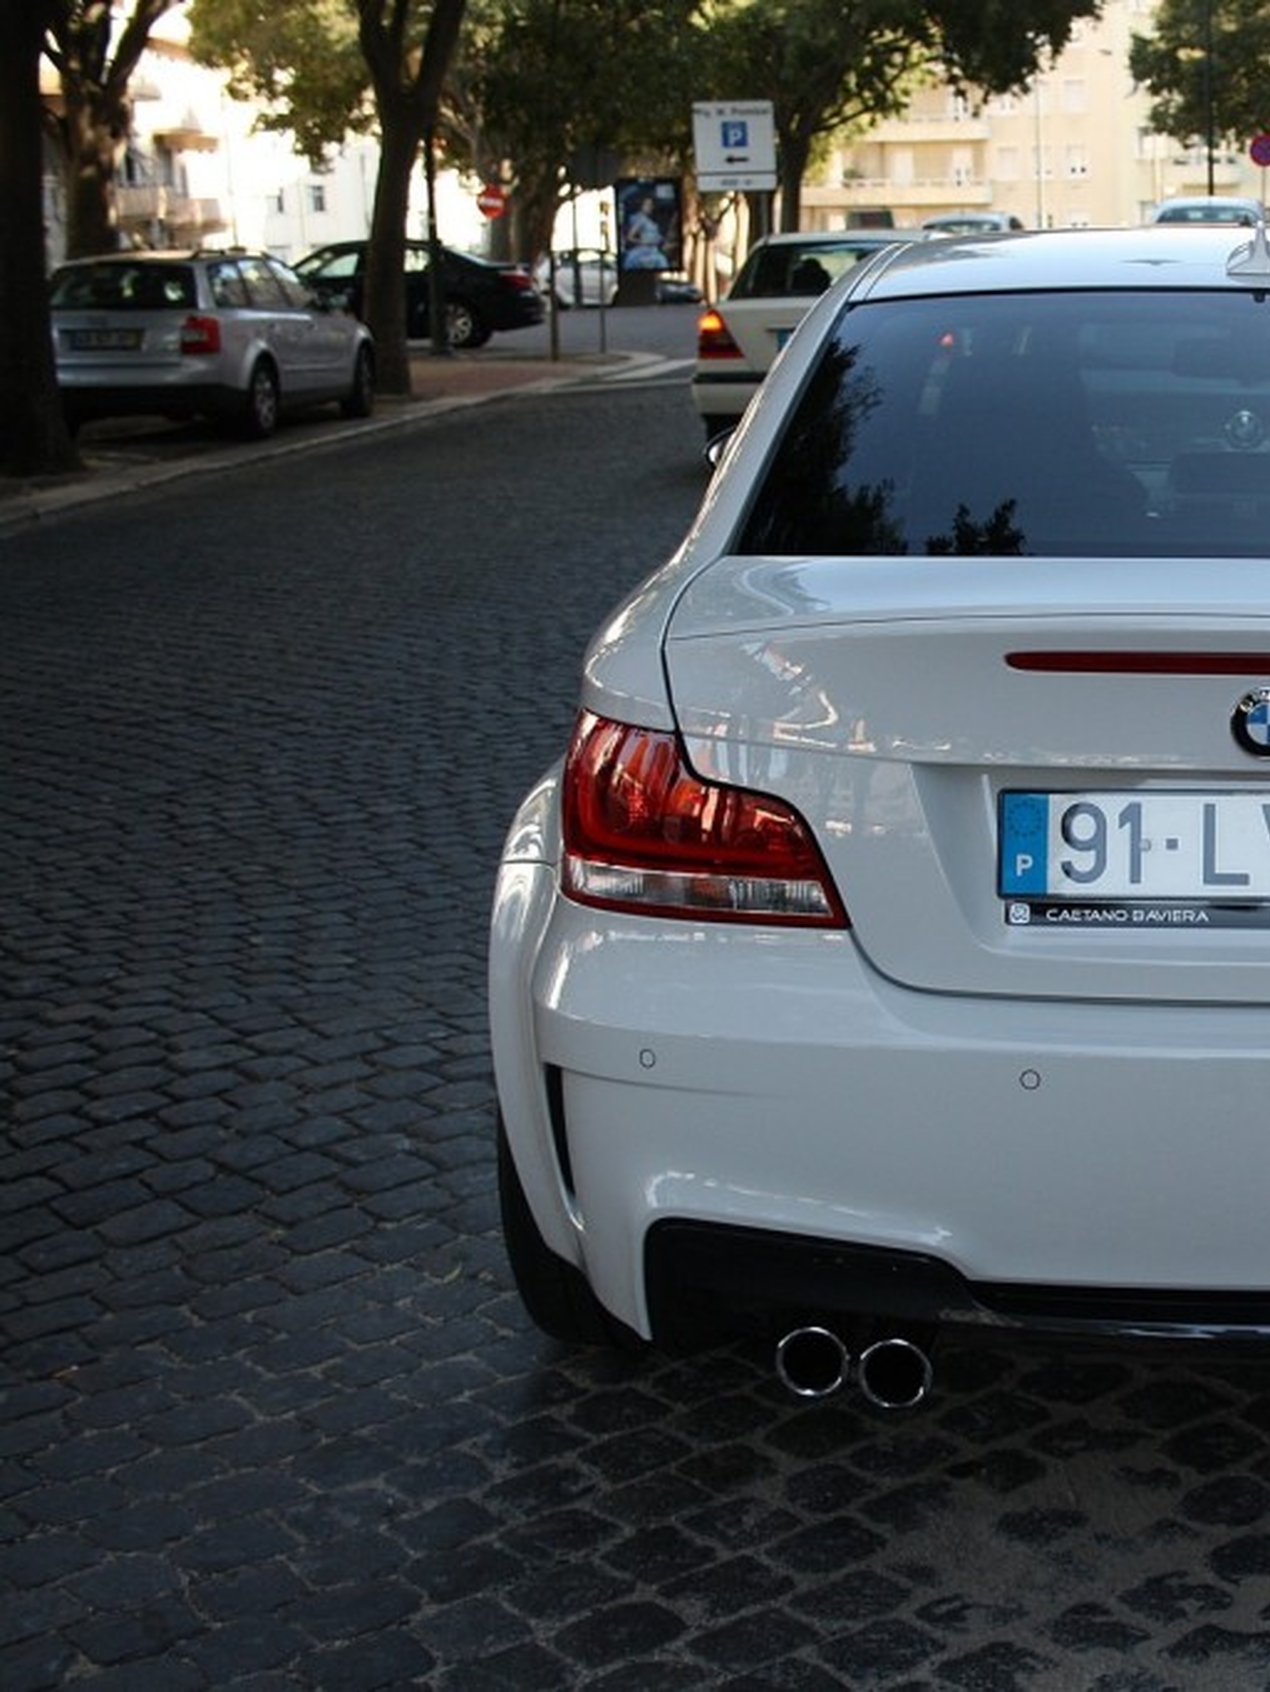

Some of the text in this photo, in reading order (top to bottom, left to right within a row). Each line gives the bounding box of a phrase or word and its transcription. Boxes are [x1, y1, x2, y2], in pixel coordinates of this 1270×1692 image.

[1015, 854, 1034, 877] P
[1046, 909, 1210, 923] CAETANO BAVIERA
